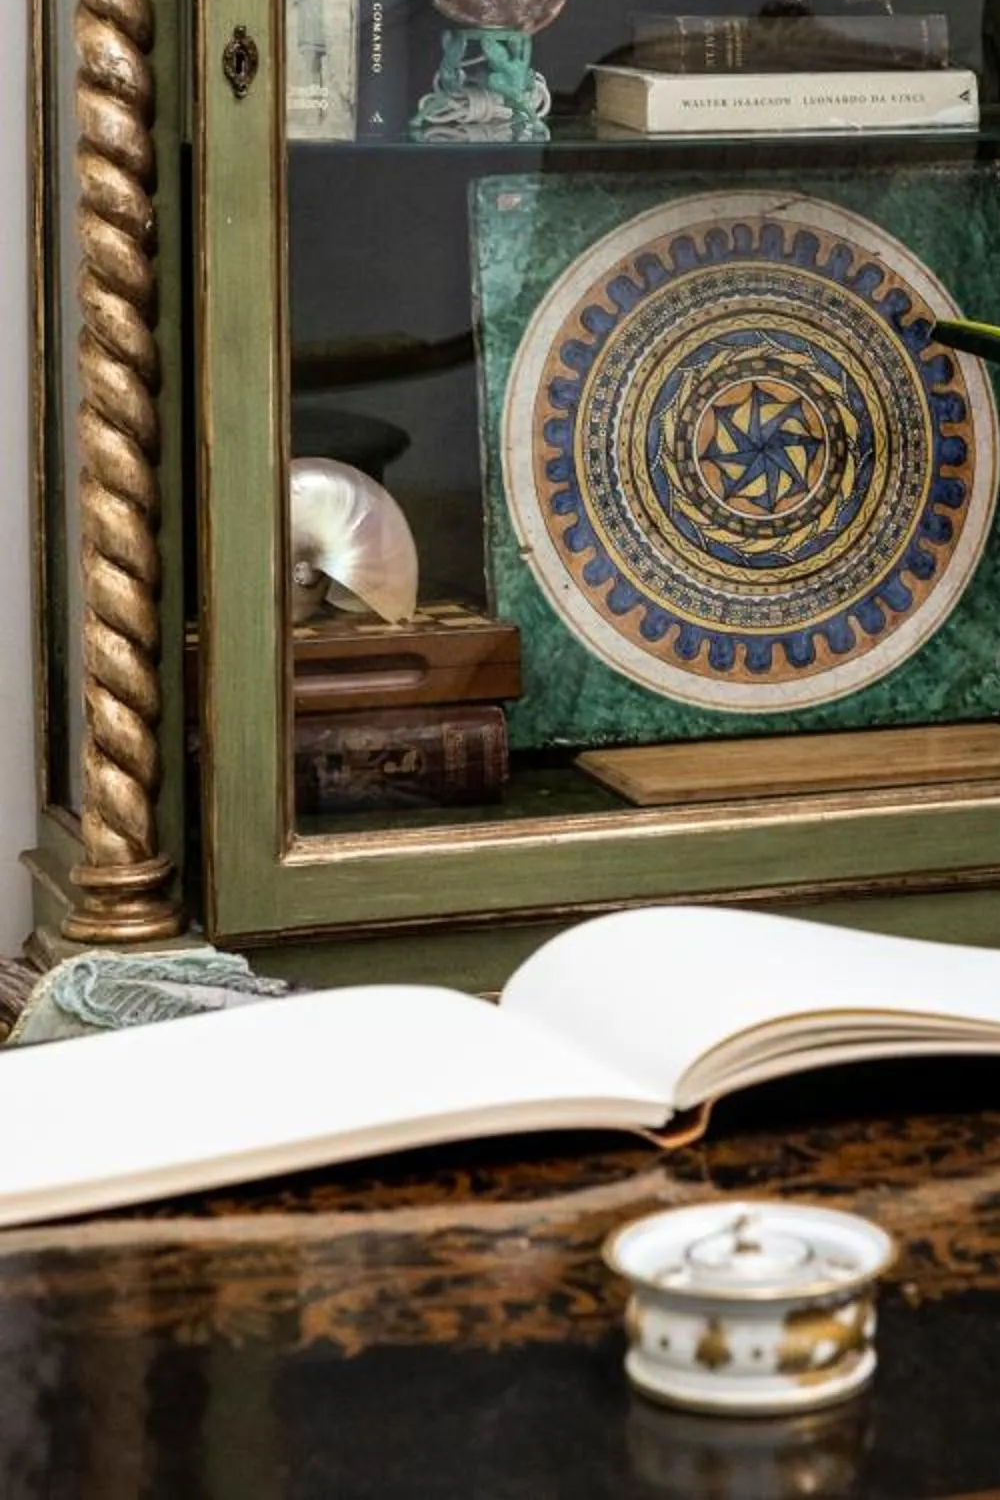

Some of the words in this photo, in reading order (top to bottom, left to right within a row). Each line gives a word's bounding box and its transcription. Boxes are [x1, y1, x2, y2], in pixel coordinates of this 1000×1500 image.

[371, 2, 383, 74] COMANDO
[681, 98, 727, 108] WALTER
[733, 96, 791, 107] ISAACSON
[803, 94, 867, 106] LEONARDO
[871, 94, 886, 103] DA
[891, 92, 926, 103] VINCI
